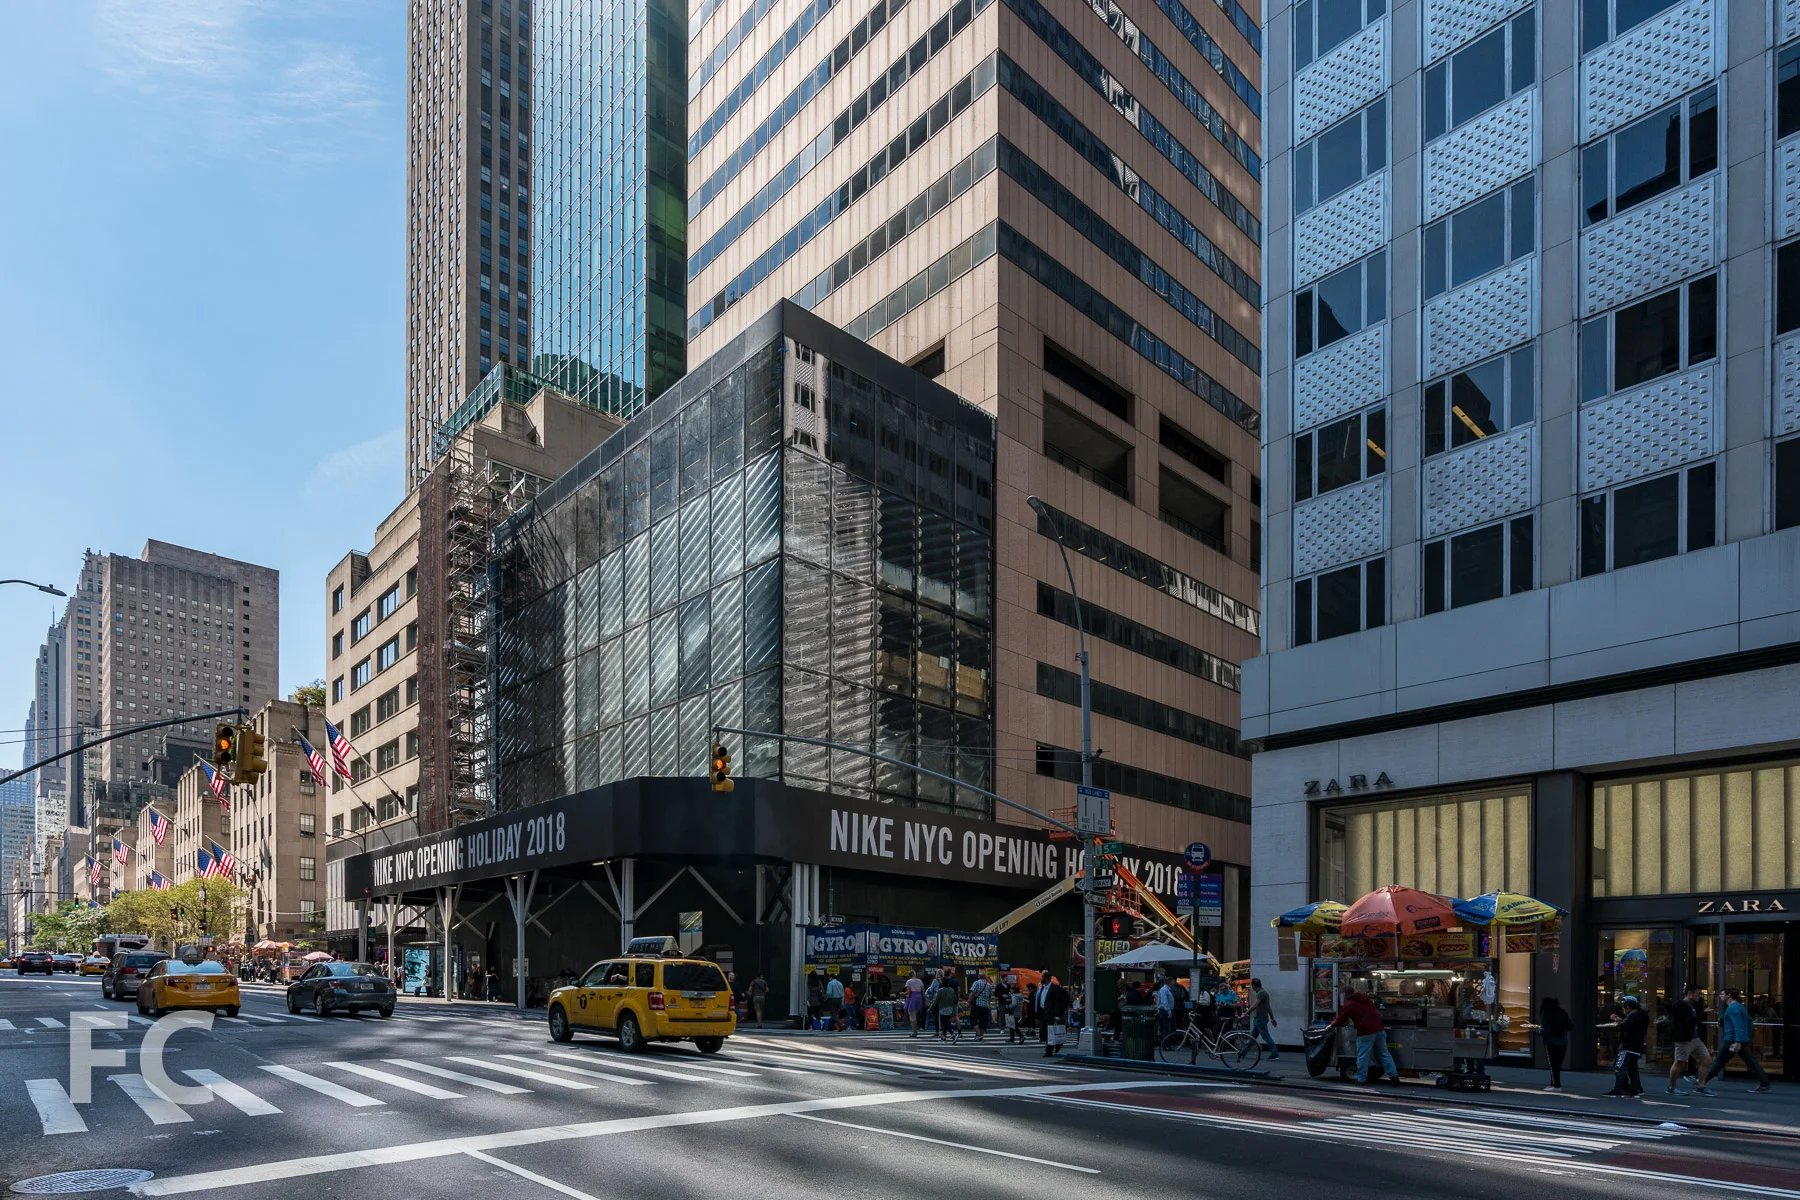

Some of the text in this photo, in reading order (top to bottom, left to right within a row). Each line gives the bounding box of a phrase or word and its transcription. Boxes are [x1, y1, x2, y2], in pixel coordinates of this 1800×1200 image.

[1304, 772, 1394, 794] ZARA
[374, 811, 566, 886] NIKE NYC OPENING HOLIDAY 2018
[830, 809, 894, 858] NIKE
[904, 821, 953, 865] NYC
[962, 830, 1057, 880] OPENING
[1103, 845, 1110, 854] 5
[1698, 899, 1788, 913] ZARA
[814, 935, 856, 951] GYRO
[880, 937, 928, 954] GYRO
[951, 941, 986, 957] GYRO
[1098, 939, 1131, 952] FRIED
